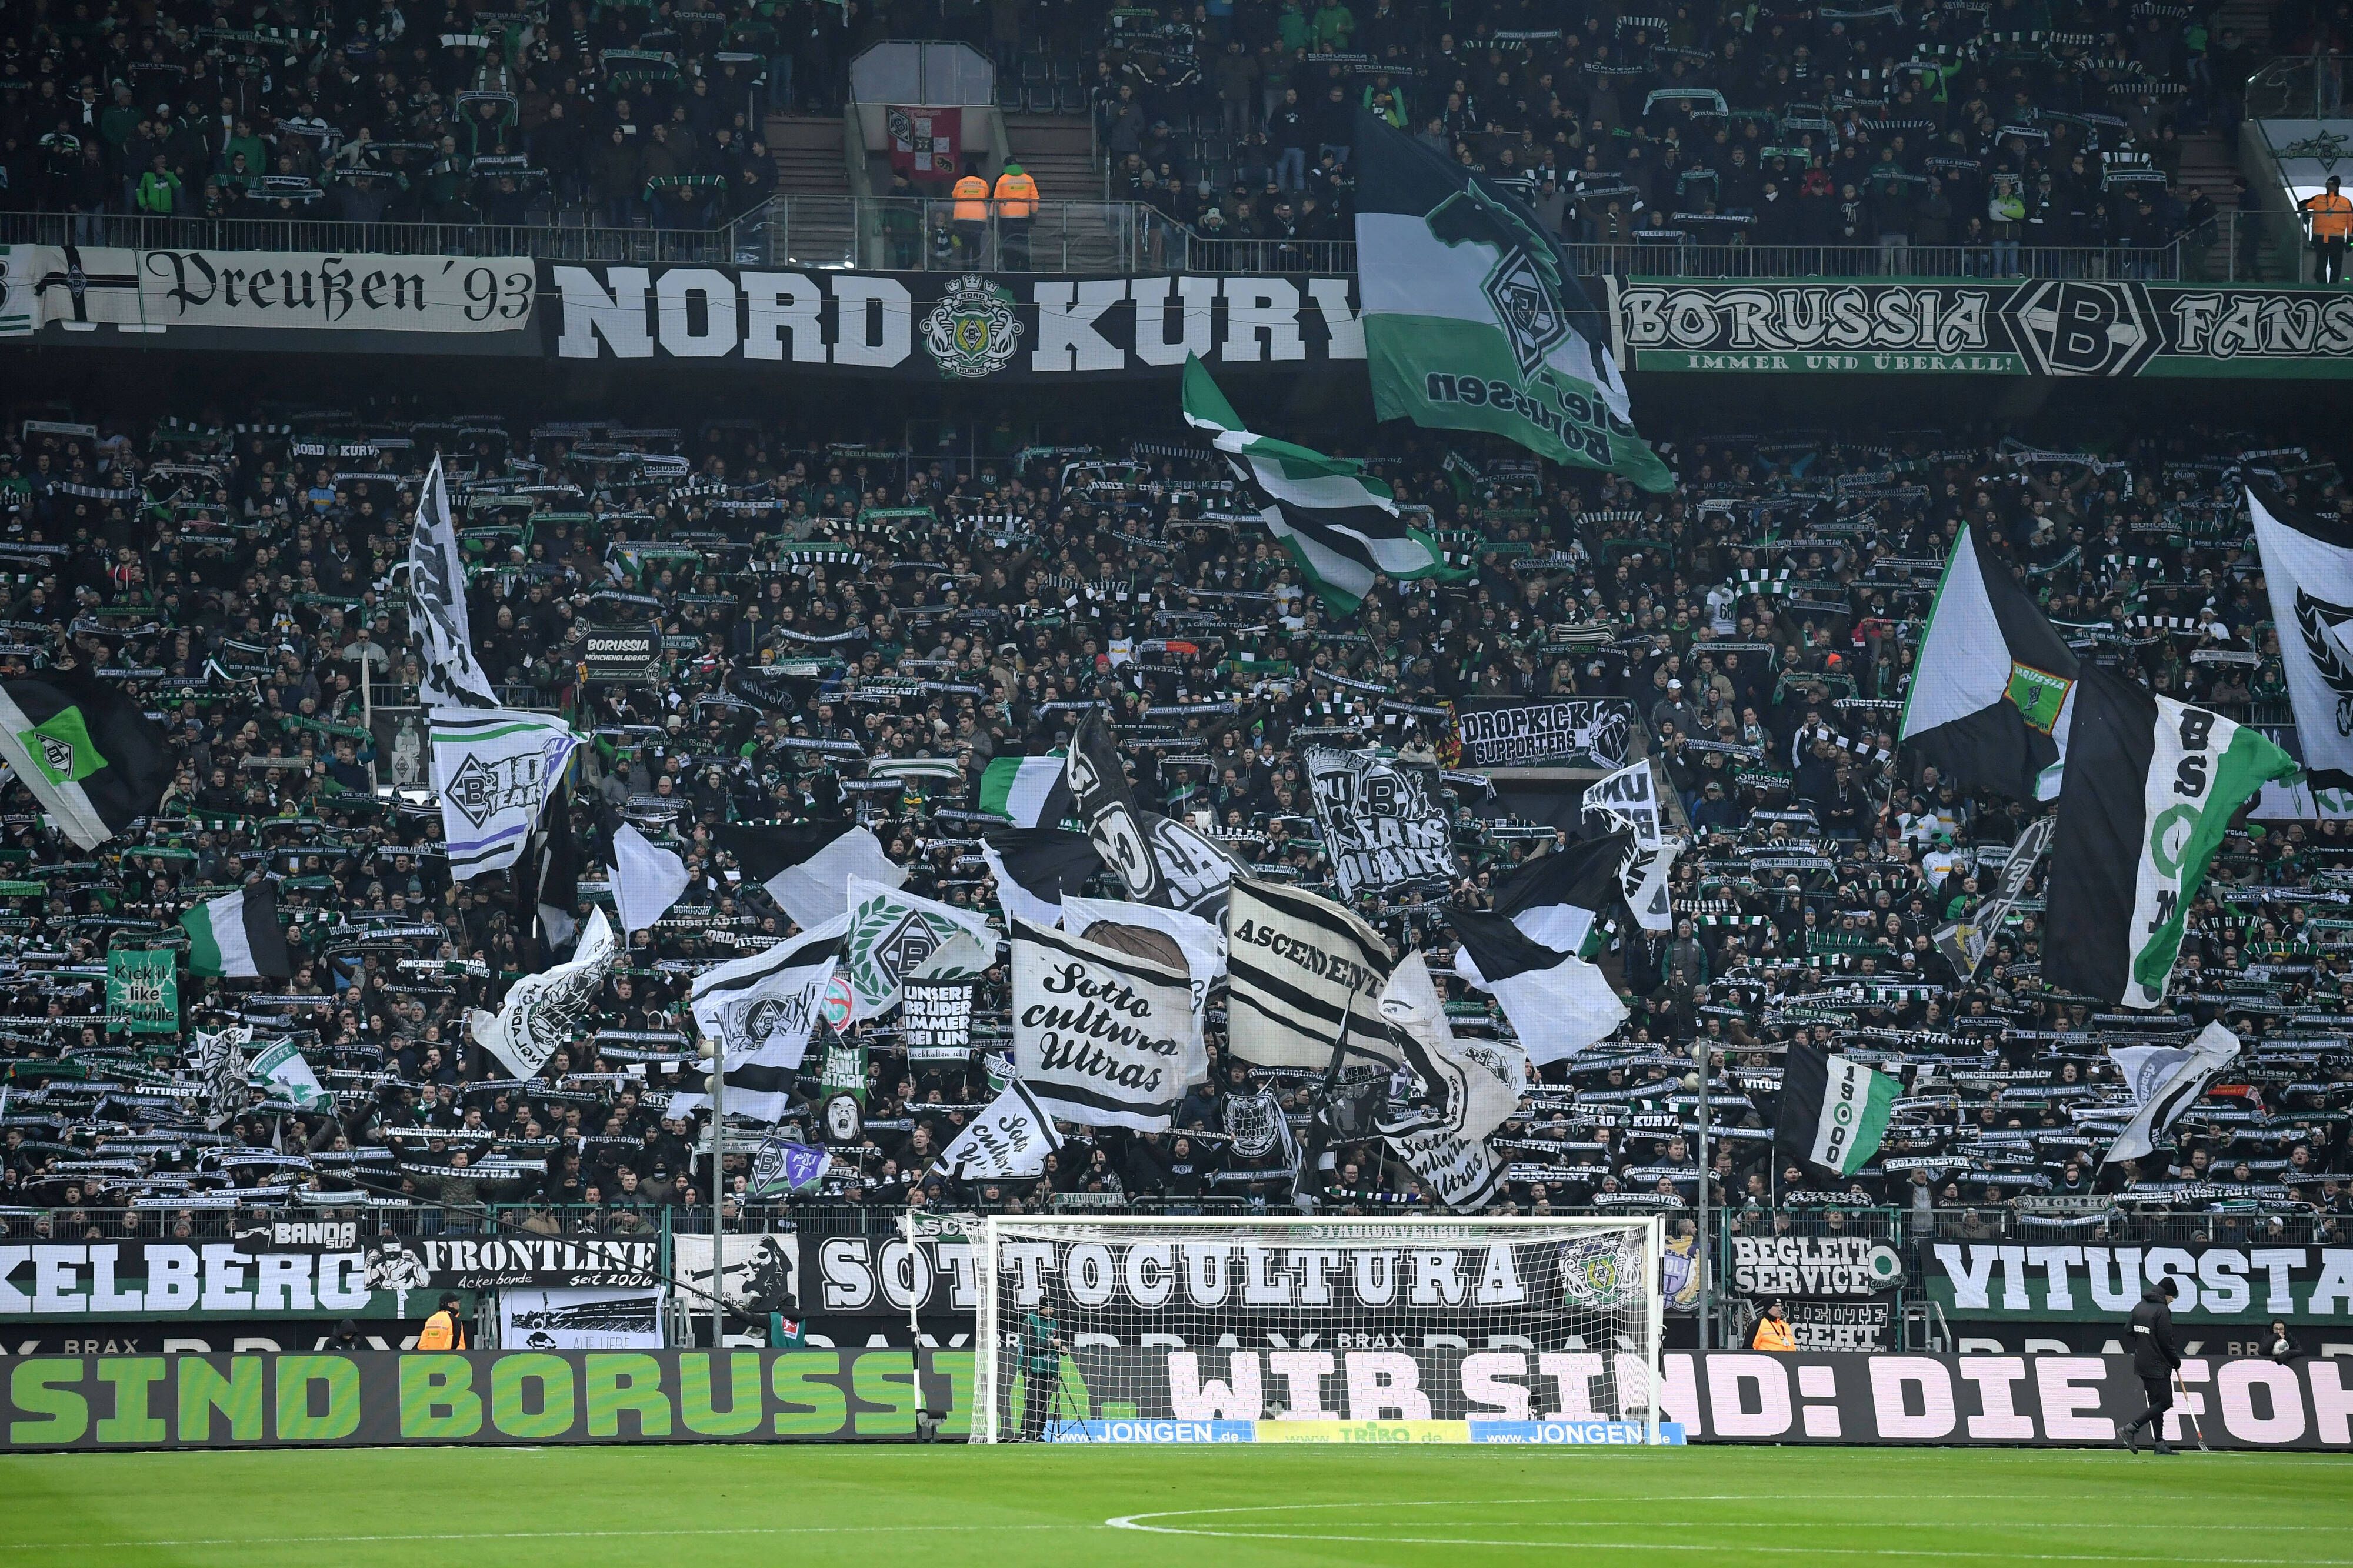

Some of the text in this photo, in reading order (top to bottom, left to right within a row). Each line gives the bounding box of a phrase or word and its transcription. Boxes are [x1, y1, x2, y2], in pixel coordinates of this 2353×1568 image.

[554, 266, 1368, 372] NORD KURV
[1619, 286, 1991, 353] BORUSSIA
[2170, 294, 2353, 356] FANS
[1687, 352, 2012, 371] IMMER UND ÜBERALL!
[341, 445, 375, 456] KURV
[588, 639, 649, 651] BORUSSIA
[1461, 701, 1588, 745] DROPKICK
[1475, 729, 1577, 765] SUPPORTERS
[1774, 859, 1798, 867] LIEBE
[654, 916, 739, 927] VITUSSTADT
[1234, 919, 1385, 1000] ASCENDENT
[115, 964, 167, 982] Kick it
[130, 986, 159, 1002] like
[904, 986, 972, 1000] UNSERE
[1043, 962, 1152, 1019] Sotto
[110, 1005, 175, 1022] Neuville
[905, 1000, 972, 1016] BRÜDER
[906, 1015, 971, 1030] IMMER
[1458, 1016, 1489, 1025] BORUSSIA
[1819, 1010, 1852, 1023] BRENNT
[2145, 1015, 2178, 1023] BORUSSIA
[646, 1032, 679, 1040] BORUSSIA
[1021, 1002, 1179, 1057] cultura
[2016, 1032, 2088, 1040] TRADTIONSVEREIN
[908, 1030, 932, 1045] BEI
[648, 1053, 682, 1061] BORUSSIA
[1040, 1031, 1162, 1092] Ultras
[822, 1072, 865, 1089] STARK
[1951, 1069, 2052, 1080] MÖNCHENGLADBACH
[84, 1083, 118, 1091] BORUSSIA
[1631, 1084, 1663, 1097] BORUSSIA
[1743, 1078, 1782, 1090] VITUS
[2053, 1086, 2086, 1095] BORUSSIA
[386, 1126, 493, 1139] MÖNCHENGLADBACH
[1732, 1127, 1767, 1136] BORUSSIA
[1957, 1146, 2035, 1162] Vitus Crew
[2255, 1160, 2288, 1169] BORUSSIA
[1998, 1174, 2032, 1182] BORUSSIA
[275, 1222, 357, 1245] BANDA
[325, 1238, 354, 1250] SUD
[1732, 1237, 1872, 1266] BEGLEIT
[422, 1240, 656, 1273] FRONTLINE
[569, 1273, 603, 1286] seit
[606, 1272, 653, 1287] 2006
[818, 1237, 1528, 1311] SOTTOCULTURA
[1735, 1265, 1872, 1295] SERVICE
[1338, 1333, 1407, 1349] BRAX
[1790, 1323, 1881, 1349] GEHT
[65, 1339, 139, 1354] BRAX
[2228, 1341, 2259, 1355] BR
[10, 1351, 2117, 1444] SIND WIR SIND: DIE
[1098, 1422, 1214, 1443] JONGEN
[1529, 1424, 1642, 1444] JONGEN
